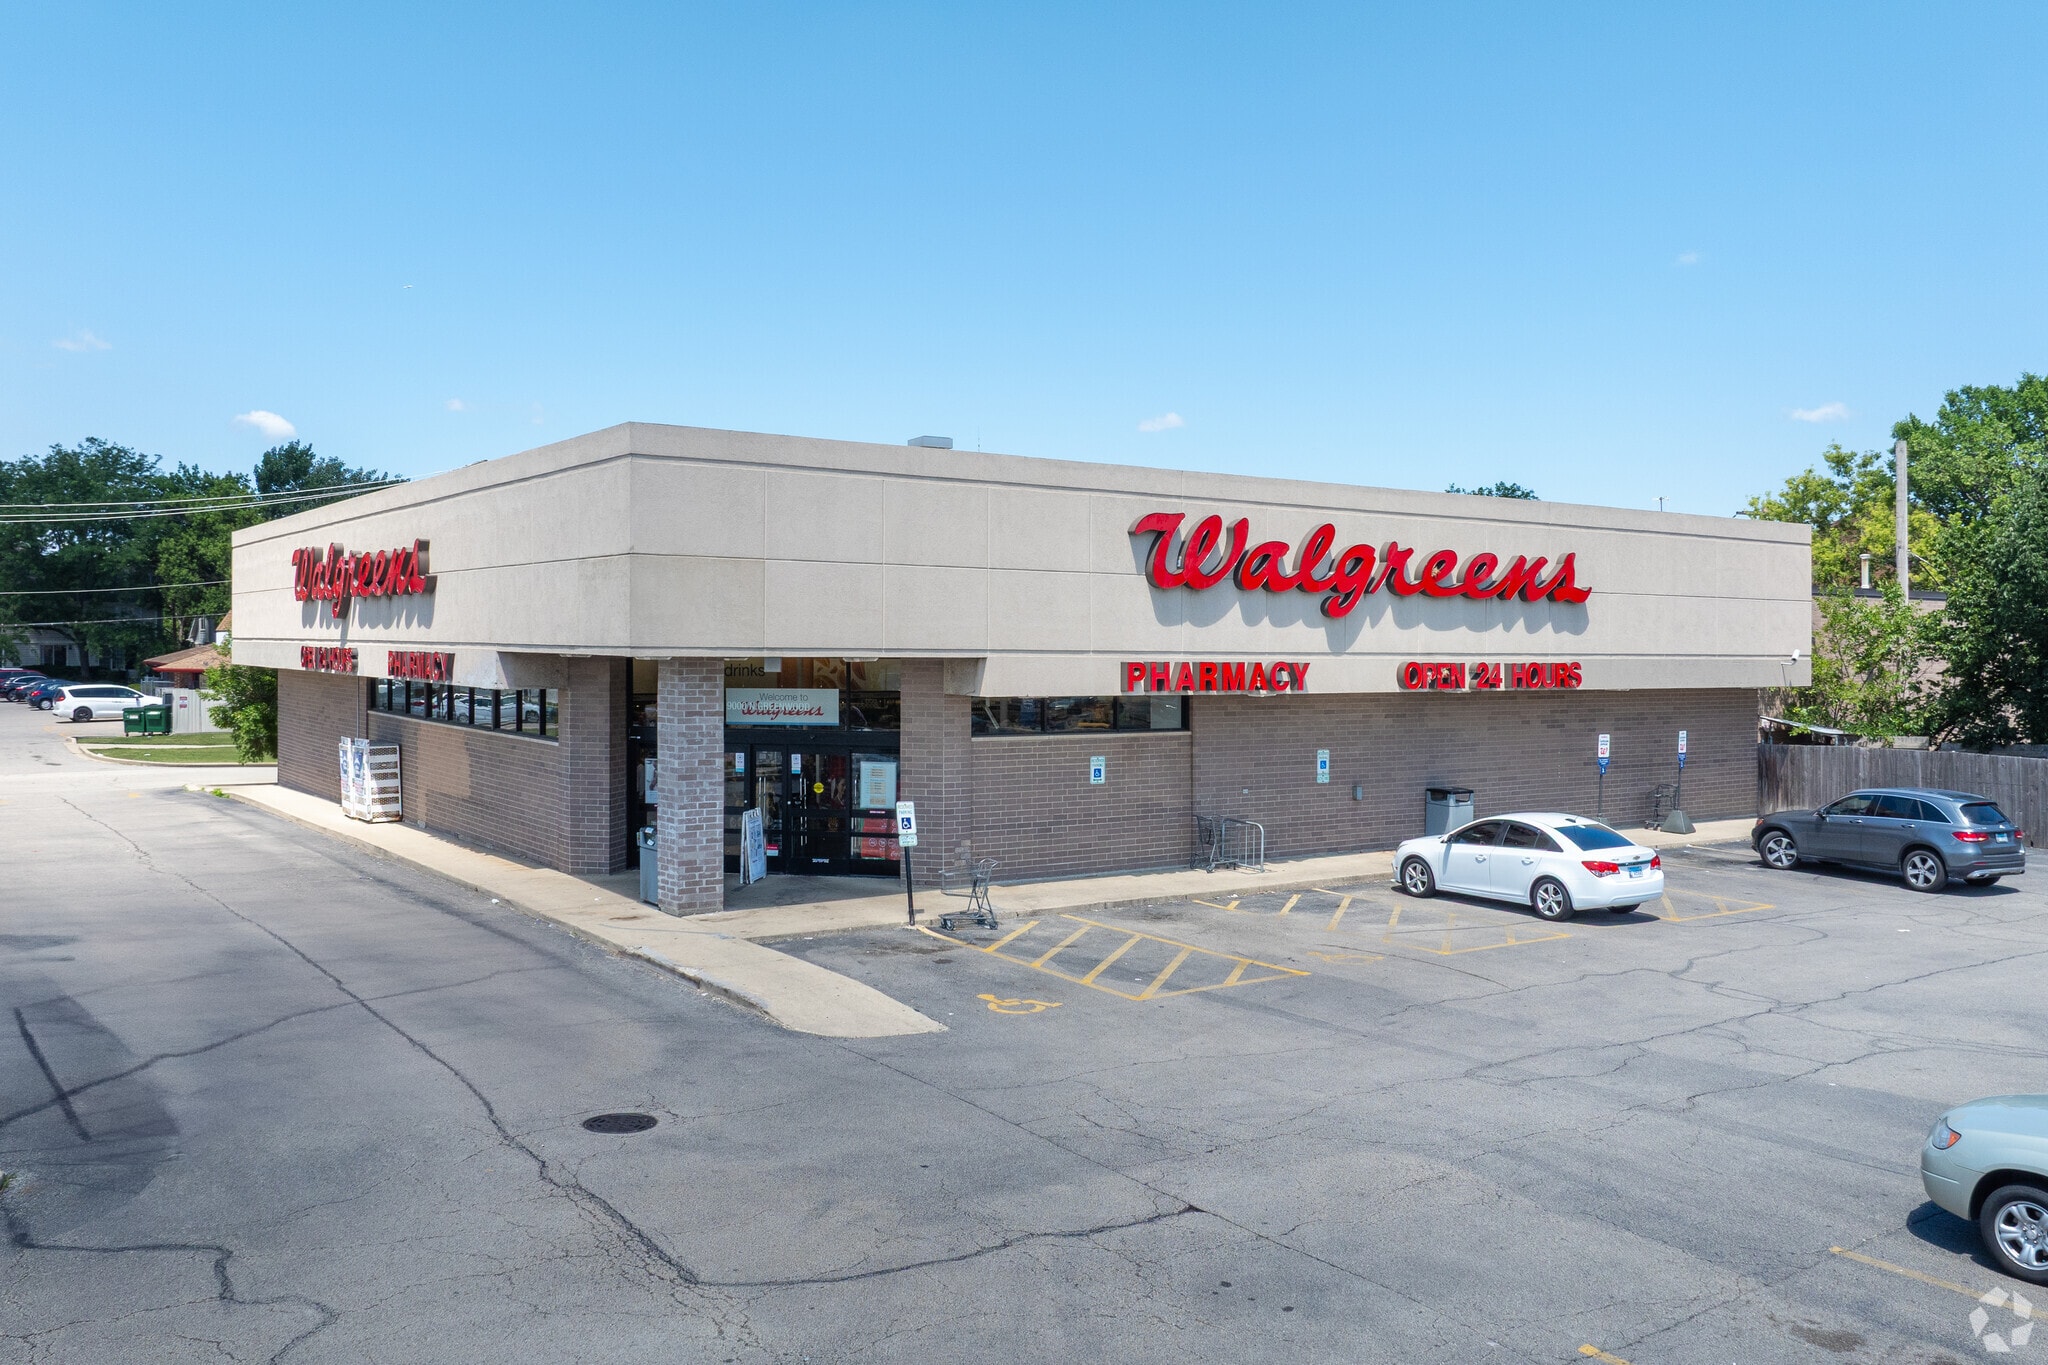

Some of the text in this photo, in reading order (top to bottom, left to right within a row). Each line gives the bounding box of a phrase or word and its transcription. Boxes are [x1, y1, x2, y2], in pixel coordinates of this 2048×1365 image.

[292, 538, 429, 619] Walgreens
[1132, 512, 1592, 618] Walgreens
[388, 650, 449, 682] PHARMACY
[724, 663, 766, 677] drinks
[1125, 661, 1310, 691] PHARMACY
[1402, 662, 1582, 689] OPEN 24 HOURS
[727, 701, 747, 710] 9000
[757, 702, 811, 711] GREENWOOD
[759, 693, 809, 701] Welcome to
